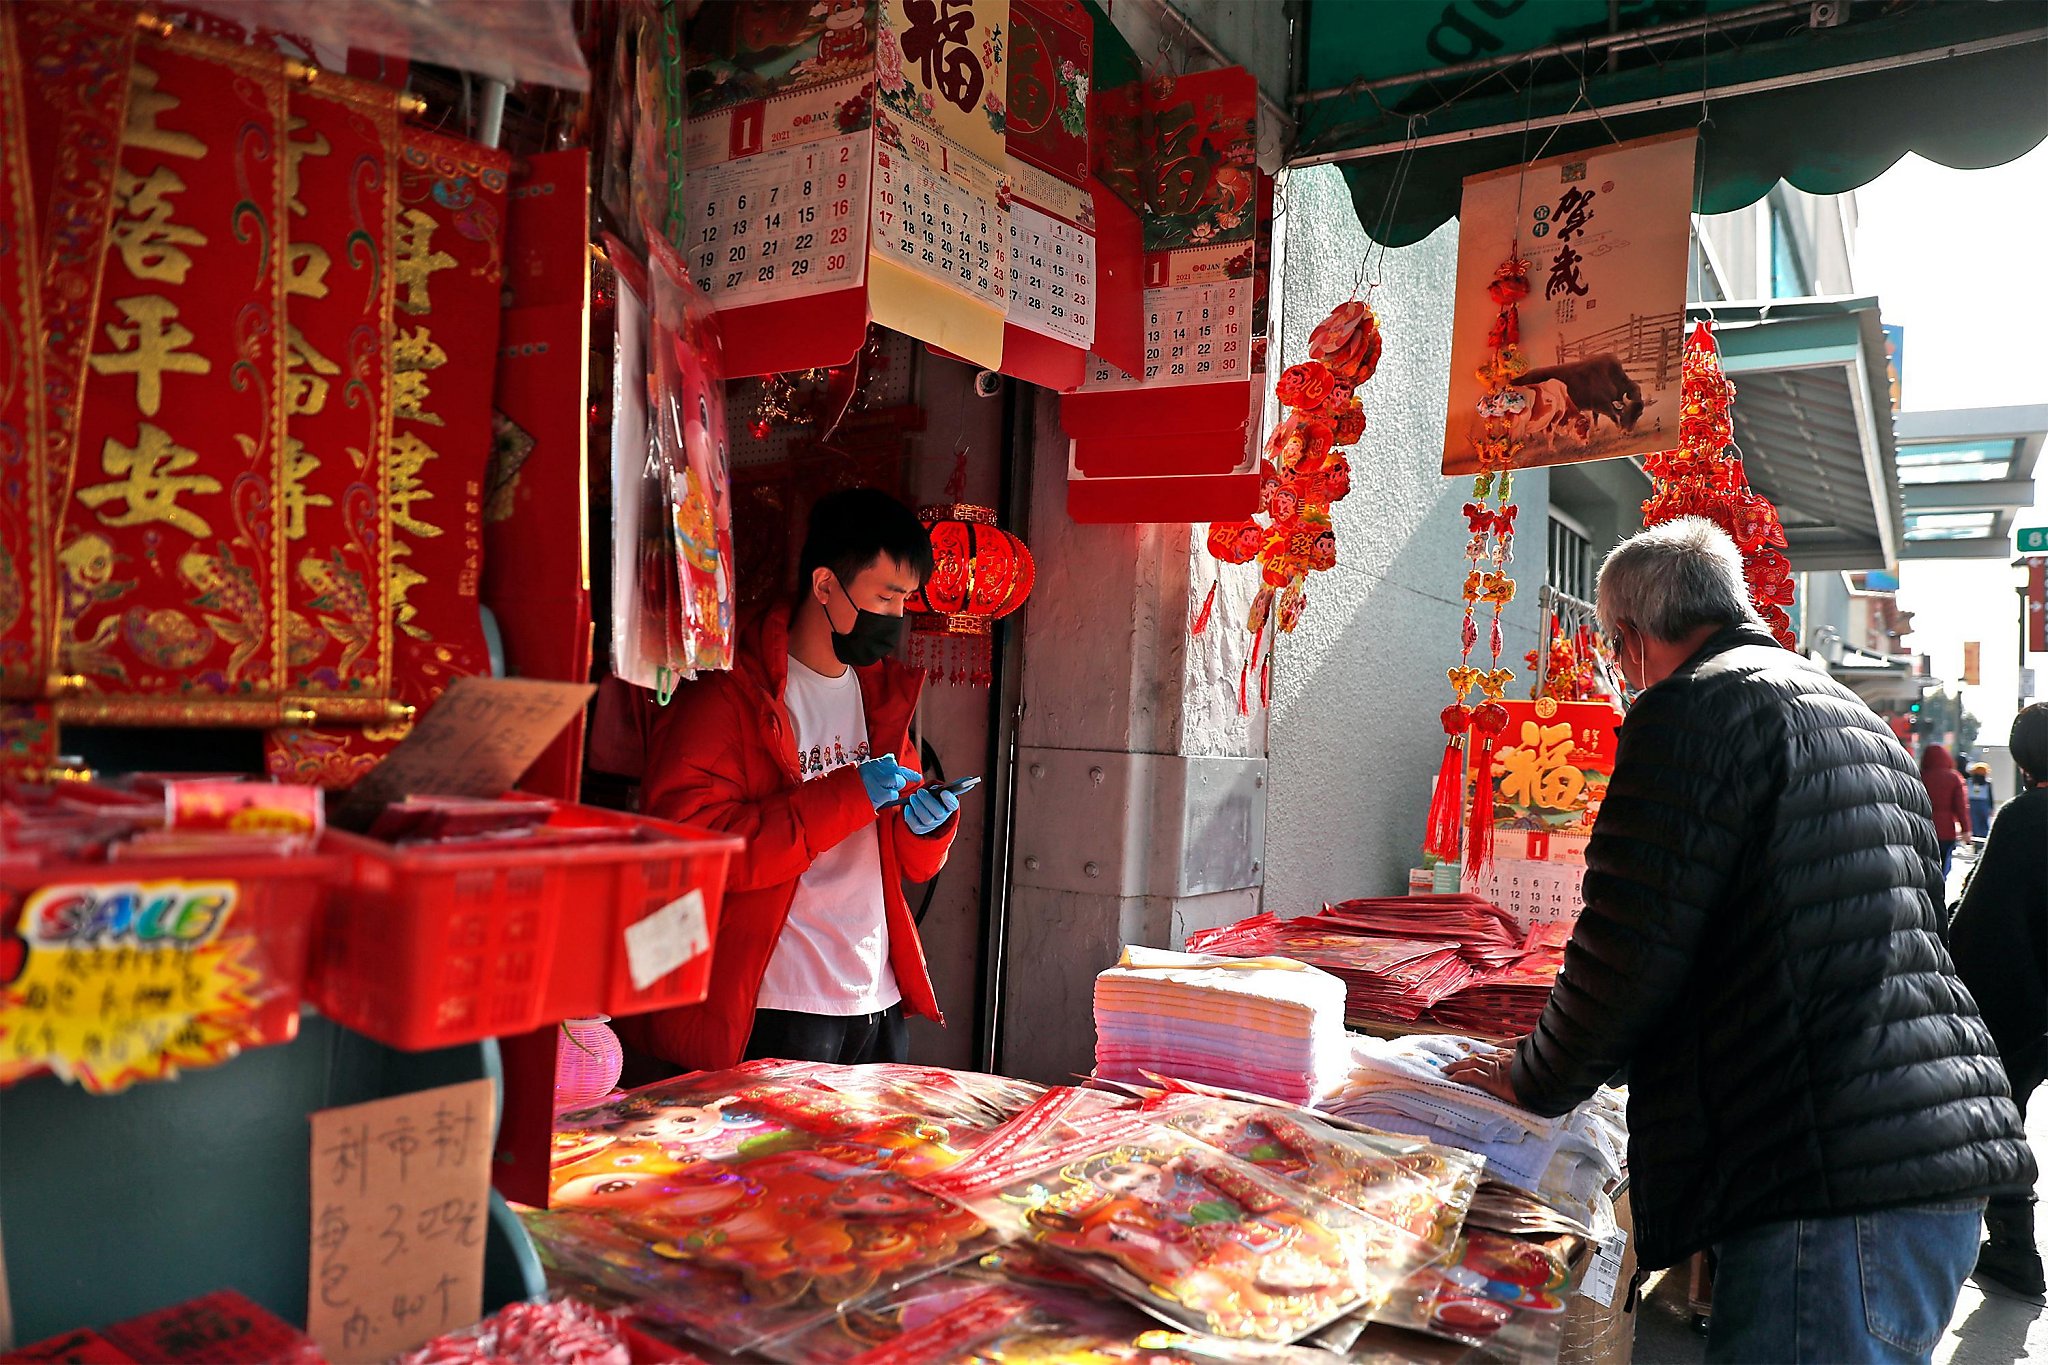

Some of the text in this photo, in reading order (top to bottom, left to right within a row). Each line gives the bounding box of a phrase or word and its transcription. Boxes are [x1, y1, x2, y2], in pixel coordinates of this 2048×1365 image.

[901, 0, 984, 113] 福
[741, 117, 752, 150] 1
[771, 131, 790, 143] 2021
[811, 111, 829, 123] JAN
[806, 147, 849, 169] 1 2
[910, 134, 950, 175] 2021 1
[707, 174, 846, 217] 5 6 7 8 9
[883, 172, 1003, 243] 3 4 5 6 7 8 9
[702, 200, 848, 242] 12 13 14 15 16
[880, 191, 1005, 262] 10 11 12 13 14 15 16
[980, 206, 1002, 226] 1 2
[700, 227, 847, 267] 19 20 21 22 23
[880, 210, 1004, 280] 17 18 19 20 21 22 23
[1010, 226, 1084, 264] 6 7 8 9
[1057, 225, 1084, 245] 1 2
[727, 272, 743, 288] 27
[758, 266, 774, 282] 28
[791, 260, 808, 276] 29
[827, 255, 845, 271] 30
[900, 240, 914, 254] 25
[922, 249, 934, 263] 26
[942, 258, 953, 271] 27
[961, 267, 971, 280] 28
[978, 276, 988, 289] 29
[994, 284, 1004, 298] 30
[1012, 248, 1086, 285] 3 14 15 16
[1152, 262, 1160, 284] 1
[1029, 276, 1041, 289] 21
[1051, 284, 1064, 298] 22
[1073, 293, 1086, 305] 23
[1203, 288, 1236, 301] 1 2
[1028, 297, 1041, 309] 28
[1051, 305, 1064, 317] 29
[1073, 313, 1085, 326] 30
[1151, 306, 1235, 324] 6 7 8 9
[1148, 323, 1237, 342] 13 14 15 16
[1146, 341, 1237, 359] 20 21 22 23
[1096, 370, 1109, 382] 25
[1146, 366, 1159, 377] 27
[1171, 364, 1184, 375] 28
[1197, 361, 1210, 373] 29
[1223, 359, 1236, 370] 30
[1501, 720, 1586, 809] 福
[1535, 840, 1541, 857] 1
[1490, 888, 1499, 896] 11
[1510, 890, 1520, 898] 12
[1531, 892, 1540, 900] 13
[1551, 894, 1561, 902] 14
[1572, 896, 1582, 904] 15
[1533, 879, 1538, 887] 6
[1554, 881, 1560, 889] 7
[1575, 883, 1580, 891] 8
[40, 892, 226, 941] SALE
[1510, 903, 1519, 911] 19
[1529, 905, 1540, 913] 20
[1550, 908, 1560, 916] 21
